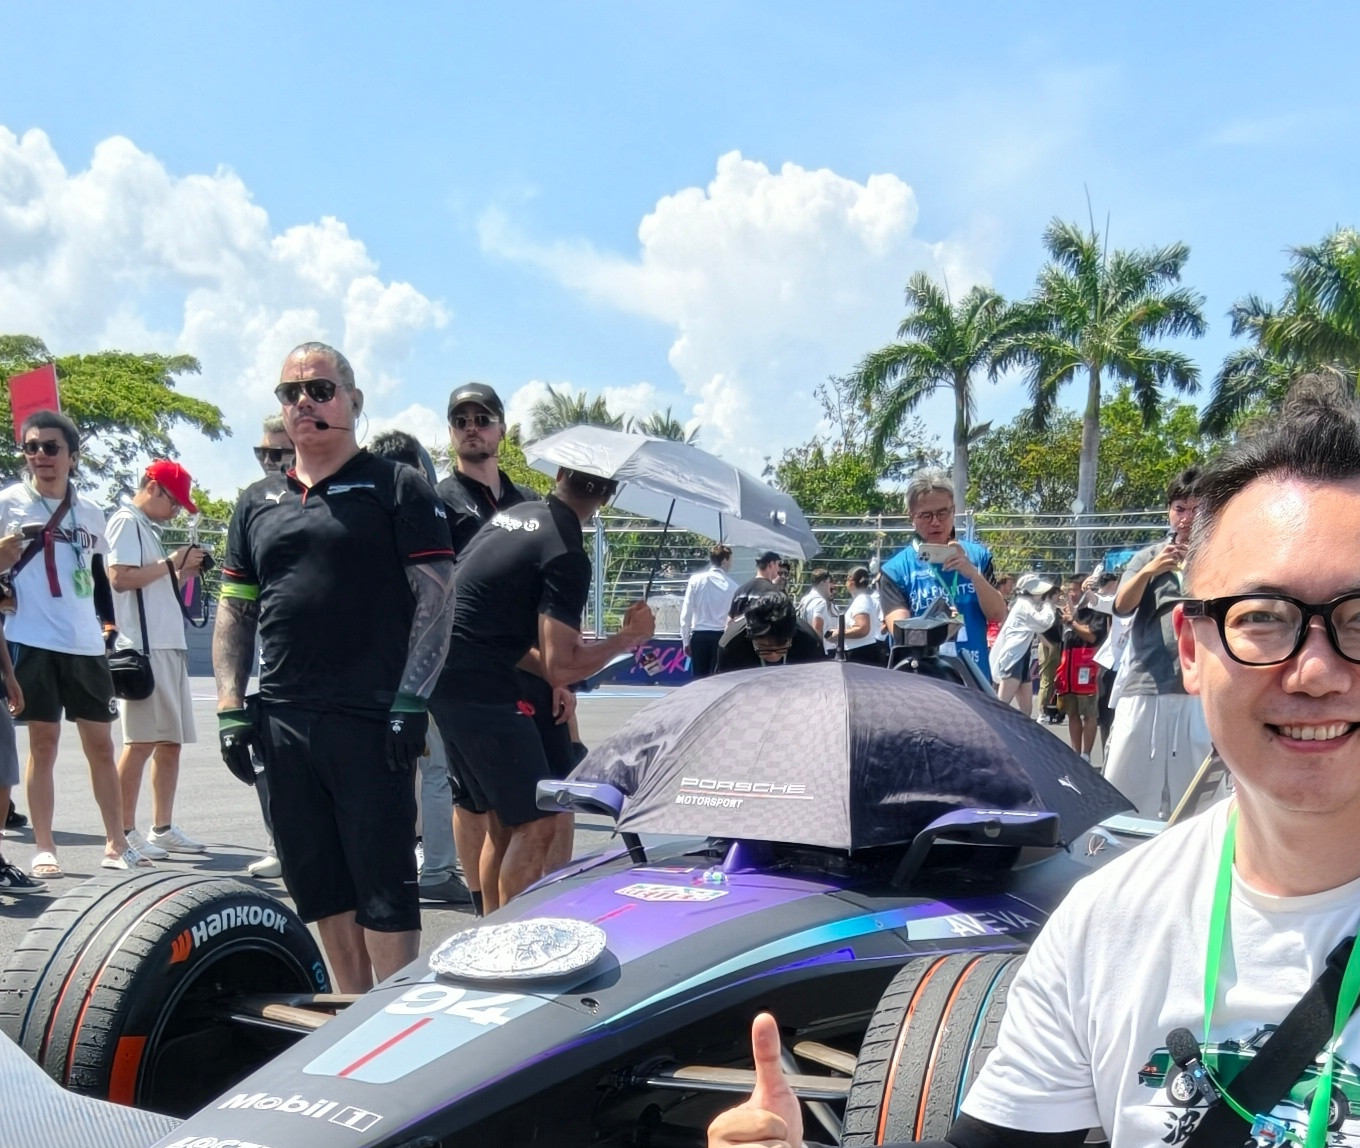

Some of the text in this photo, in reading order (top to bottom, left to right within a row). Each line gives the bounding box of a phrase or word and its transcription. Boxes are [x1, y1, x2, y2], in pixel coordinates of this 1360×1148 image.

[680, 776, 807, 794] PORSCHE
[674, 794, 744, 810] MOTORSPORT
[384, 984, 528, 1026] 94
[217, 1092, 339, 1119] Mobil
